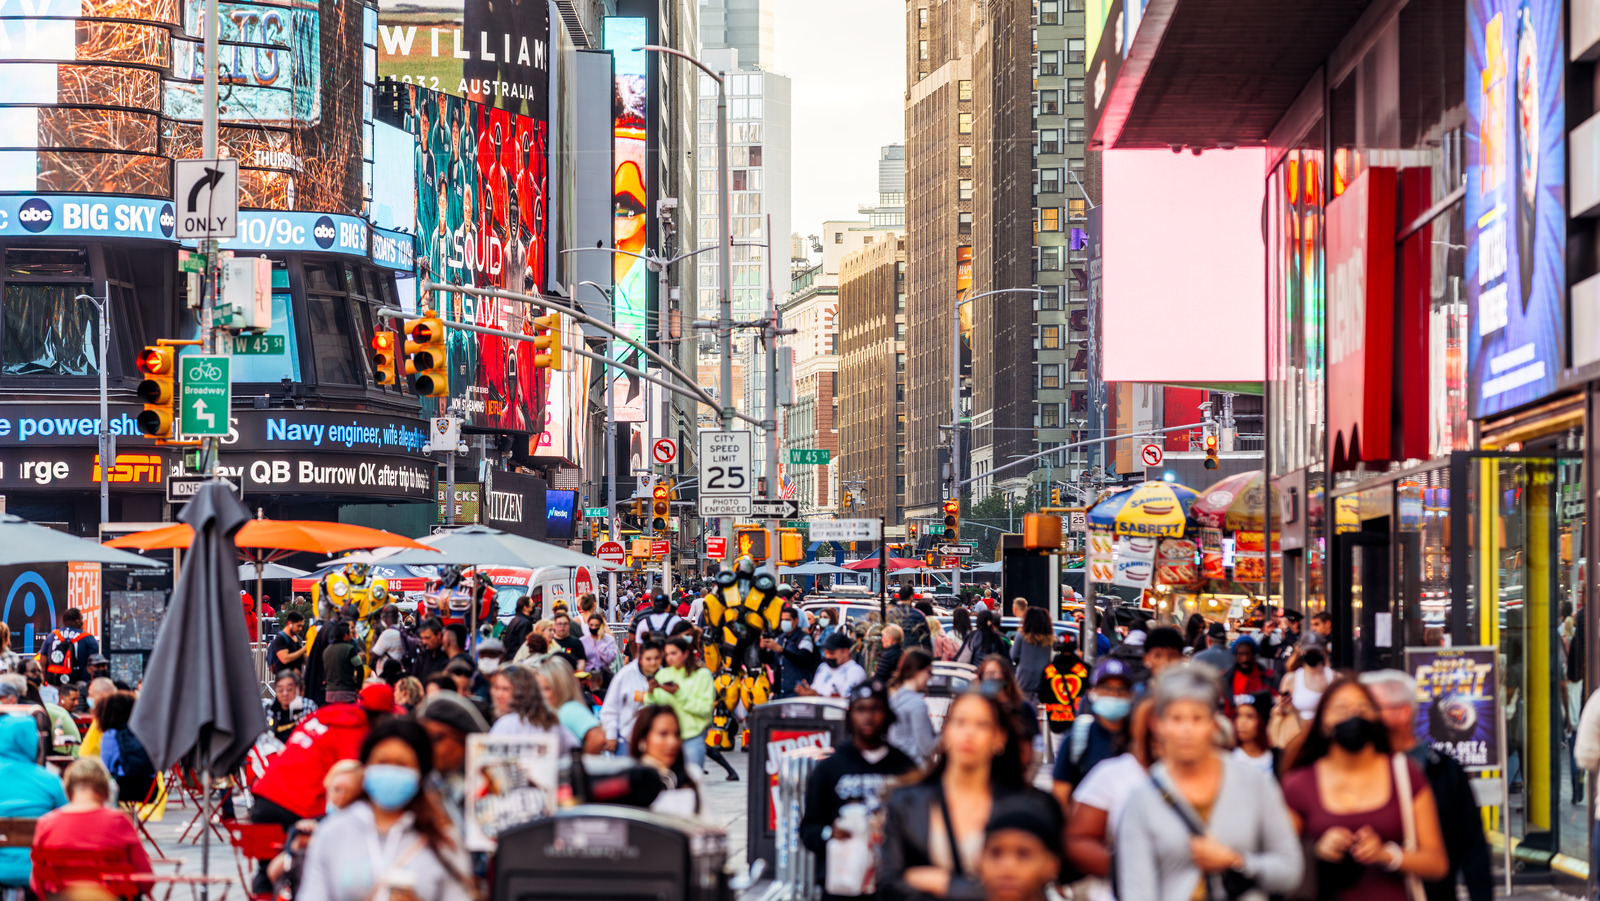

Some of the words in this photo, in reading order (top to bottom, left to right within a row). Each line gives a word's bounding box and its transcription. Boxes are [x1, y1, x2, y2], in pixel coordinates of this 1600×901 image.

[457, 78, 535, 101] AUSTRALIA
[19, 207, 53, 222] abc
[63, 203, 108, 230] BIG
[114, 205, 156, 232] SKY
[159, 214, 174, 228] abc
[238, 217, 305, 248] 10/9c
[314, 224, 336, 239] abc
[340, 223, 359, 248] BIG
[185, 217, 228, 232] ONLY
[448, 212, 502, 288] SQUID
[462, 283, 513, 333] GAME
[236, 338, 247, 352] W
[253, 337, 269, 353] 45
[274, 338, 283, 348] St
[184, 386, 226, 396] Broadway
[462, 399, 485, 414] STEAMING
[19, 417, 101, 442] power
[266, 418, 325, 446] Navy
[328, 421, 381, 449] engineer,
[383, 423, 398, 446] wife
[398, 425, 419, 453] allegedly
[710, 445, 740, 453] SPEED
[713, 455, 737, 463] LIMIT
[792, 451, 801, 463] W
[805, 451, 818, 463] 45
[822, 451, 829, 459] St
[20, 460, 69, 485] rge
[92, 454, 162, 483] ESPN
[250, 460, 292, 485] QB
[299, 460, 356, 484] Burrow
[359, 462, 376, 486] OK
[378, 464, 399, 487] after
[399, 465, 409, 493] trip
[707, 466, 745, 489] 25
[178, 483, 201, 497] ONE
[438, 490, 478, 503] BCKS
[440, 504, 463, 515] FE
[554, 509, 568, 518] Nasdaq
[752, 505, 767, 513] ONE
[775, 505, 791, 513] WAY
[1072, 516, 1085, 524] 25
[930, 525, 935, 534] W
[937, 525, 945, 534] 44
[1119, 521, 1181, 535] SABRETT
[495, 575, 526, 585] TESTING
[68, 571, 100, 610] RECH
